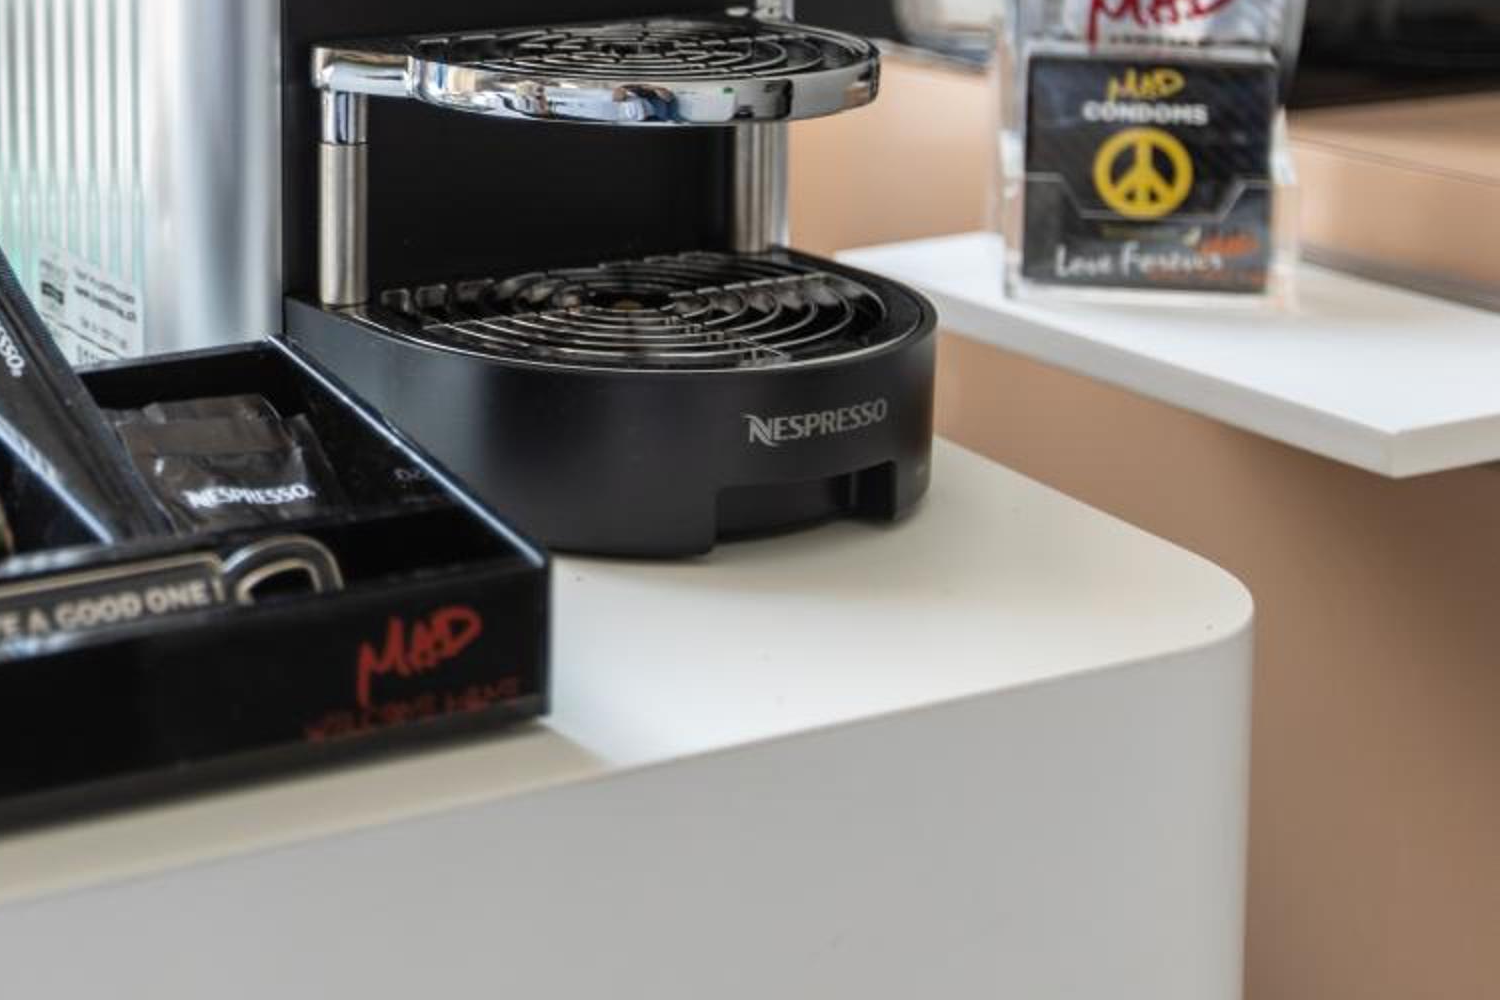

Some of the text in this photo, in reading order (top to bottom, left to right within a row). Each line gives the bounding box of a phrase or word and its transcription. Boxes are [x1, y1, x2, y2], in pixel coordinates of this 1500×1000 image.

[1107, 66, 1187, 106] MAD
[1082, 101, 1209, 127] CONDOMS
[740, 398, 888, 447] NESPRESSO
[182, 482, 310, 509] NESPRESSO
[27, 608, 49, 634] A
[54, 588, 143, 630] GOOD
[356, 603, 483, 708] MAD
